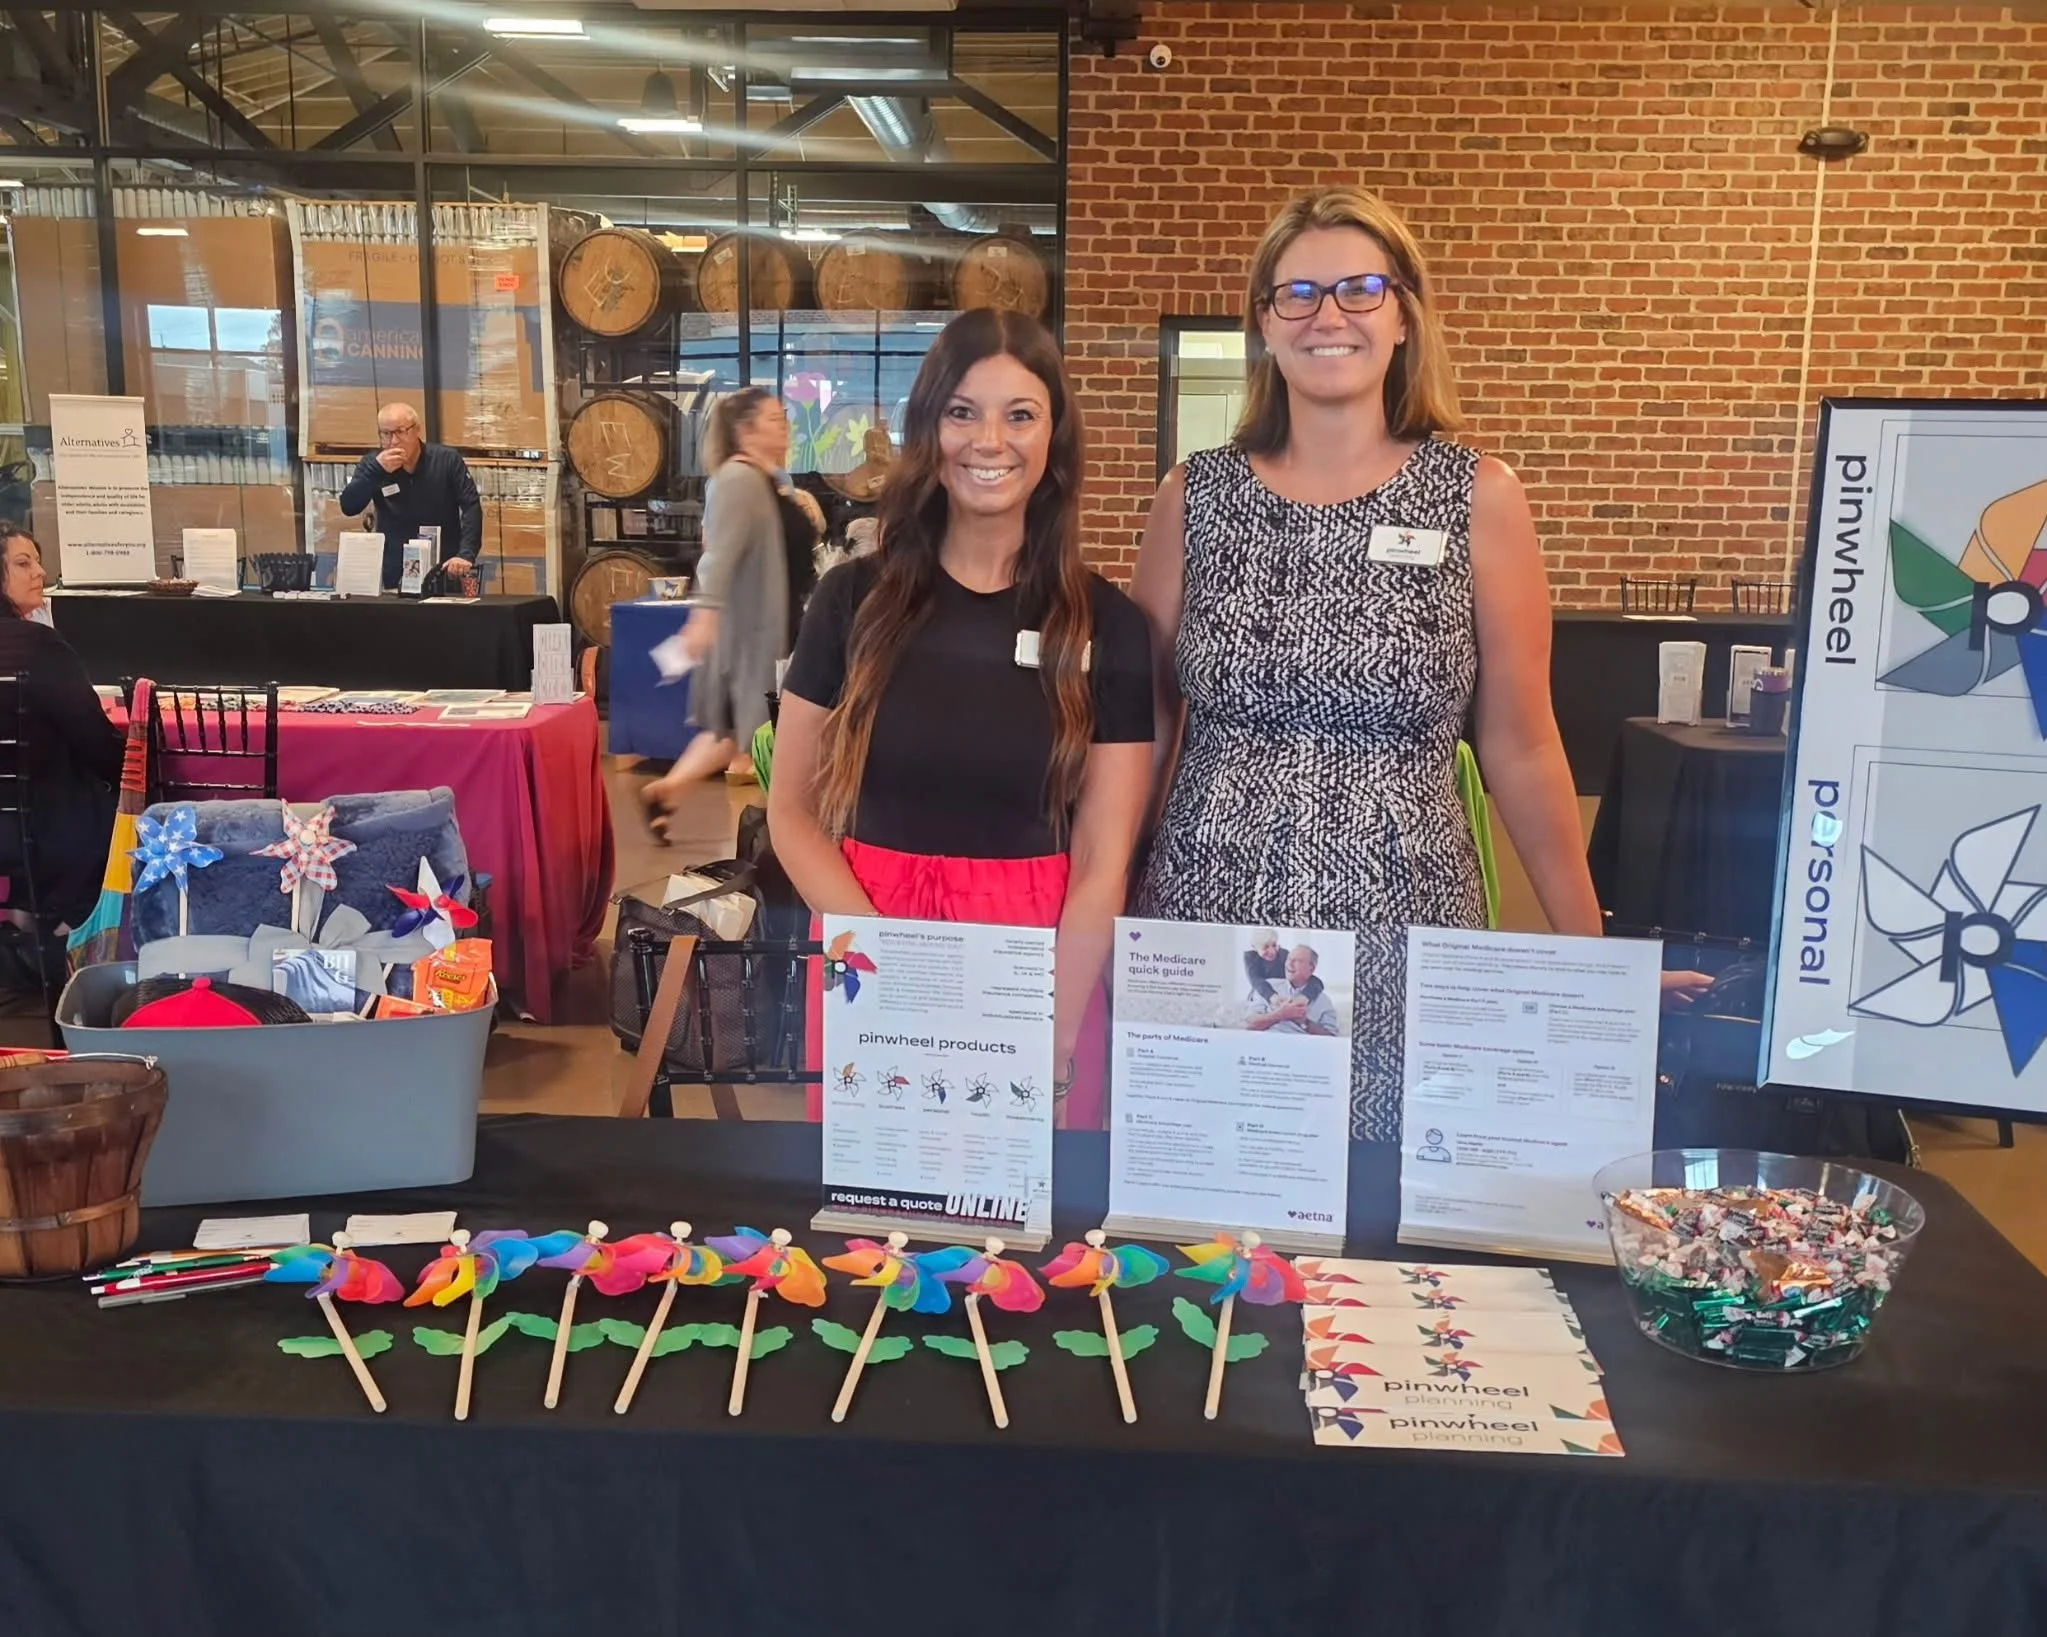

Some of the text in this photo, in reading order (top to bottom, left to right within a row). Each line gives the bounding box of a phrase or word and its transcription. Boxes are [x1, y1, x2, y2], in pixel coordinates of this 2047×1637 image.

[349, 252, 399, 263] FRAGILE
[347, 343, 423, 359] CANNIN
[60, 436, 120, 447] Alternatives
[1825, 453, 1872, 666] pinwheel
[927, 934, 964, 942] purpose
[1129, 952, 1206, 965] The Medicare
[1128, 964, 1194, 978] quick guide
[859, 1031, 1017, 1054] pinwheel products
[1173, 1035, 1209, 1044] Medicare
[831, 1192, 1030, 1222] request a quote ONLINE
[1297, 1210, 1333, 1223] aetna
[1384, 1380, 1530, 1397] pinwheel
[1405, 1395, 1512, 1410] planning
[1389, 1416, 1539, 1432] pinwheel
[1412, 1431, 1523, 1445] planning
